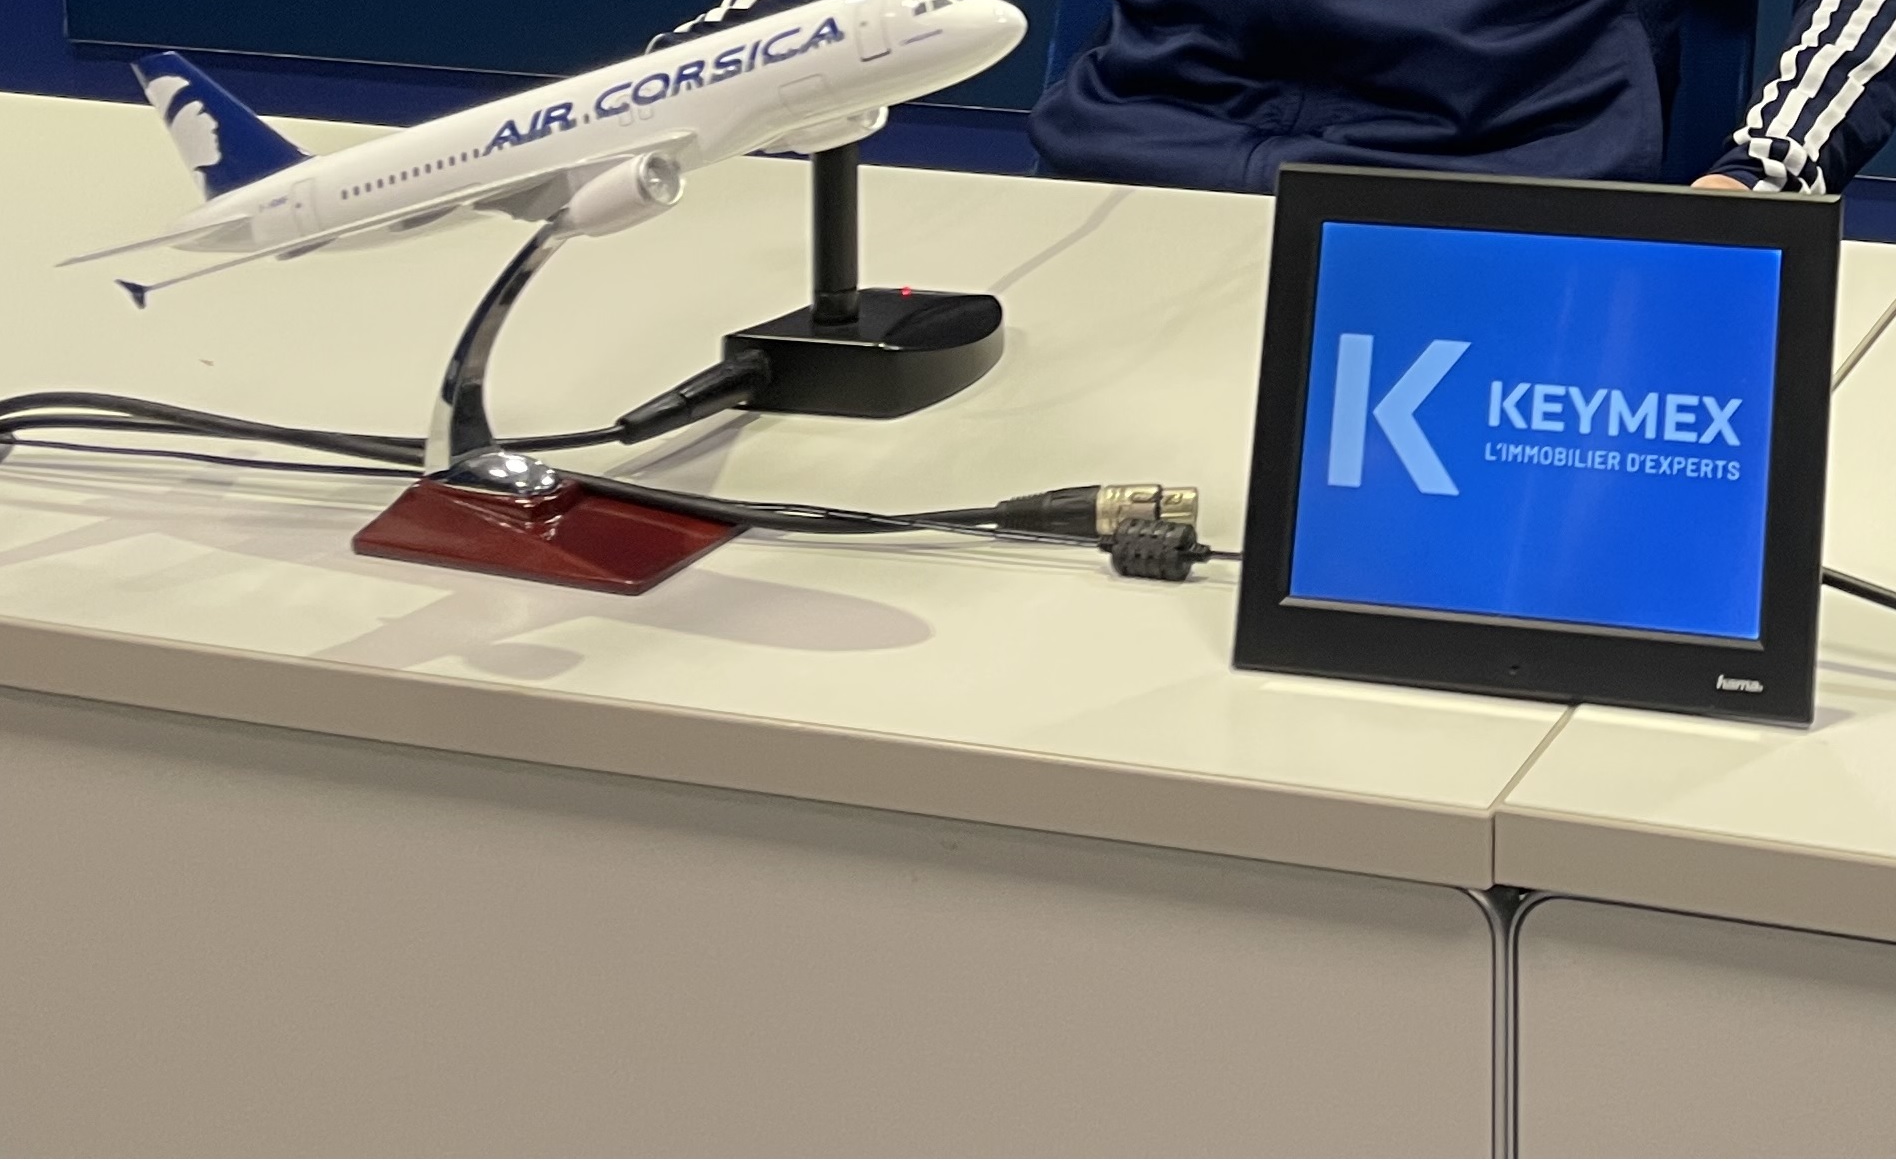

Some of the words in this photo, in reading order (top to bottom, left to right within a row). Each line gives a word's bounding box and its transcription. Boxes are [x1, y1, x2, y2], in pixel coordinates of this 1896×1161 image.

[481, 101, 576, 157] AIR
[593, 16, 845, 120] CORSICA
[1327, 333, 1472, 496] K
[1484, 442, 1620, 471] L'IMMOBILIER
[1626, 452, 1741, 481] D'EXPERTS
[1487, 380, 1744, 448] KEYMEX
